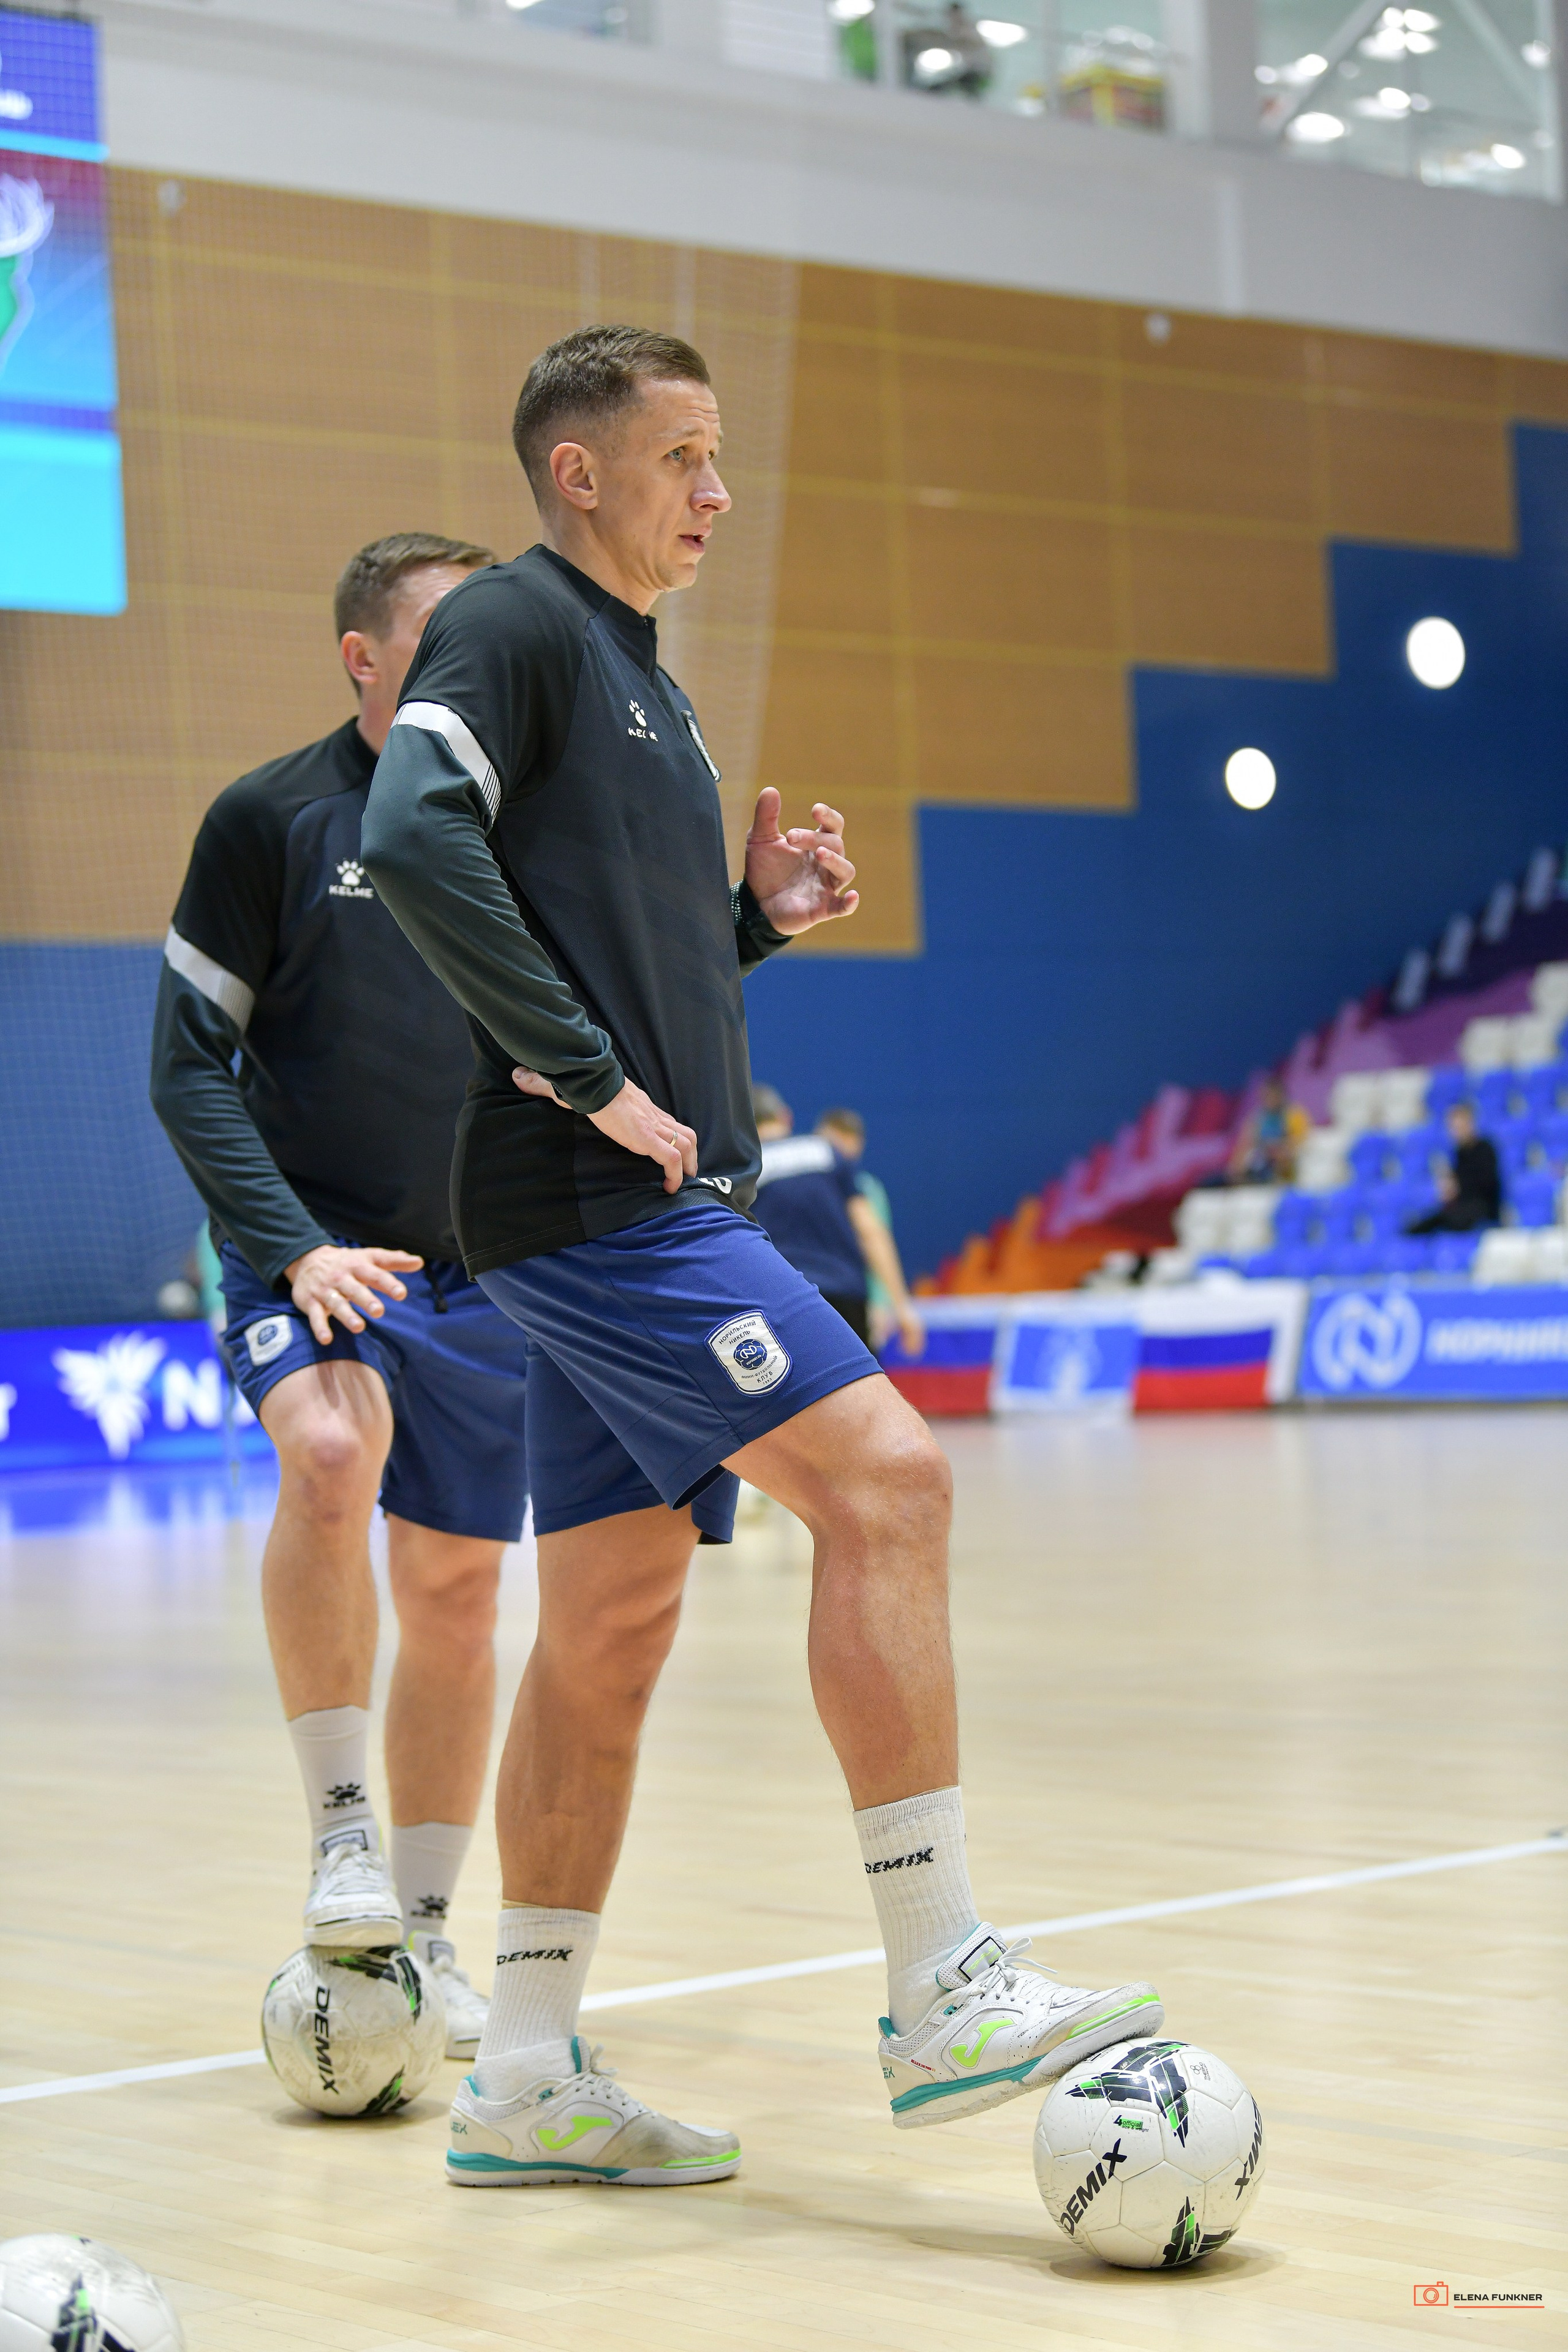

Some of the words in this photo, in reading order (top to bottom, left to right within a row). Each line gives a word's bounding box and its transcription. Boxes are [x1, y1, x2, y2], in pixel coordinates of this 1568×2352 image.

[328, 884, 374, 899] KELME
[718, 1319, 756, 1344] НОРИЛЬСКИЙ
[728, 1330, 750, 1345] НИКЕЛЬ
[756, 1370, 773, 1383] КЛУБ
[497, 1948, 573, 1966] DEMIX
[314, 1985, 340, 2095] DEMIX
[1060, 2138, 1128, 2236] DEMIX
